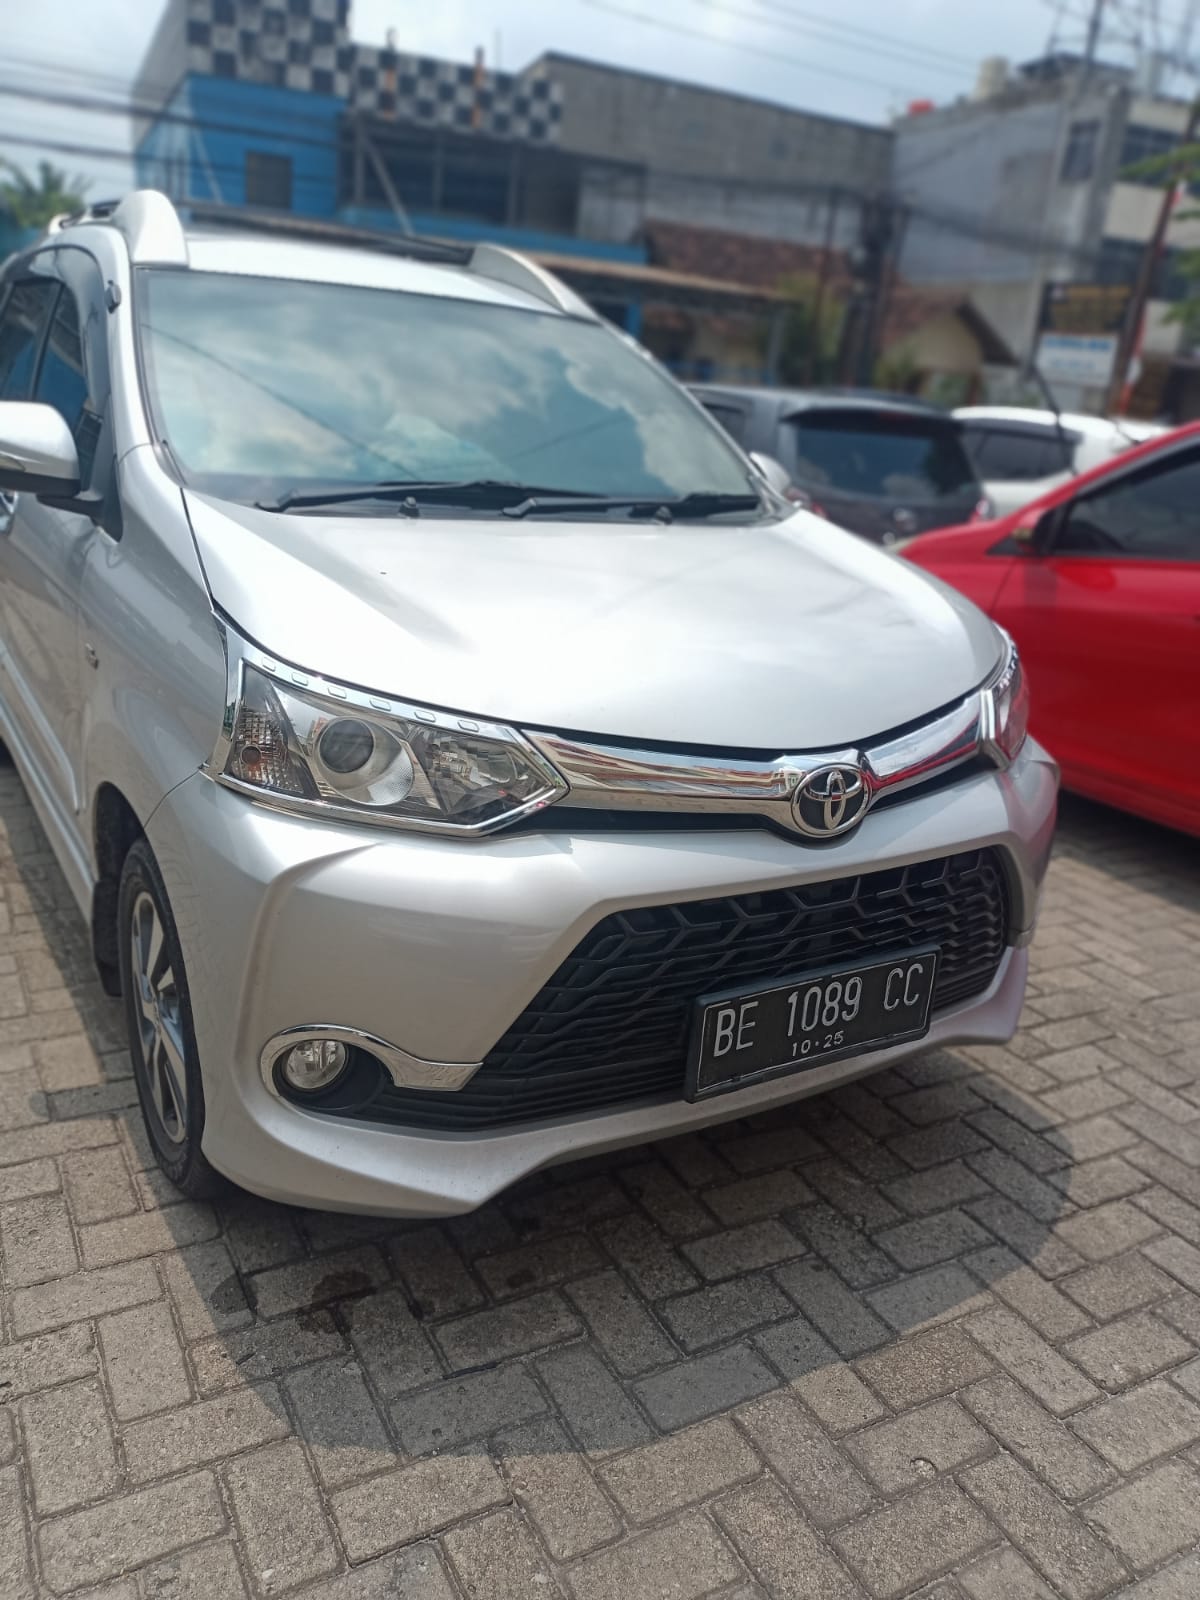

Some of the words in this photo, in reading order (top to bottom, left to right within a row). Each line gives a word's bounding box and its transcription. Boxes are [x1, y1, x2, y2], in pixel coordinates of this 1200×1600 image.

[713, 1001, 758, 1057] BE
[787, 976, 862, 1037] 1089
[883, 963, 923, 1010] CC
